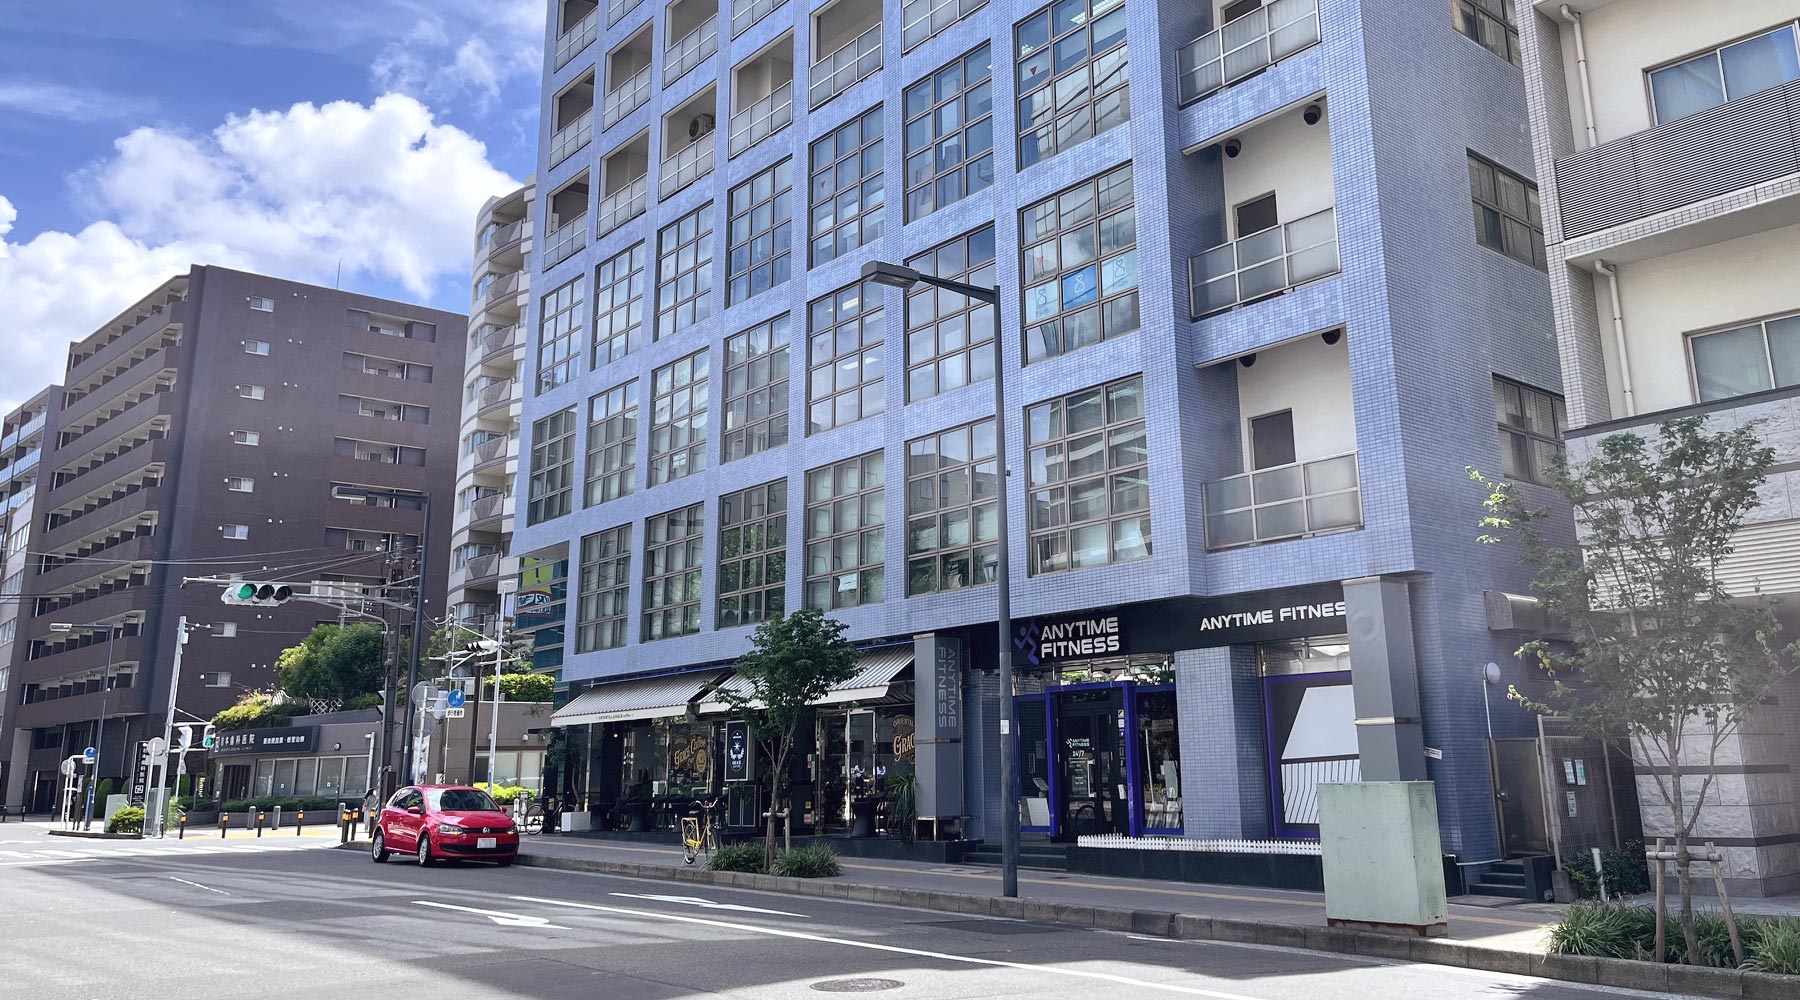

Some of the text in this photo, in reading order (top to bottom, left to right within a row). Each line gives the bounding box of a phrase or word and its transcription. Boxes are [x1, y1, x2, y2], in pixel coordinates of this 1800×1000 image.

[1041, 617, 1119, 640] ANYTIME
[1200, 601, 1346, 631] ANYTIME FITNES
[1041, 635, 1120, 659] FITNESS
[938, 646, 947, 728] FITNESS
[947, 647, 957, 728] ANYTIME
[893, 733, 915, 762] GRAC
